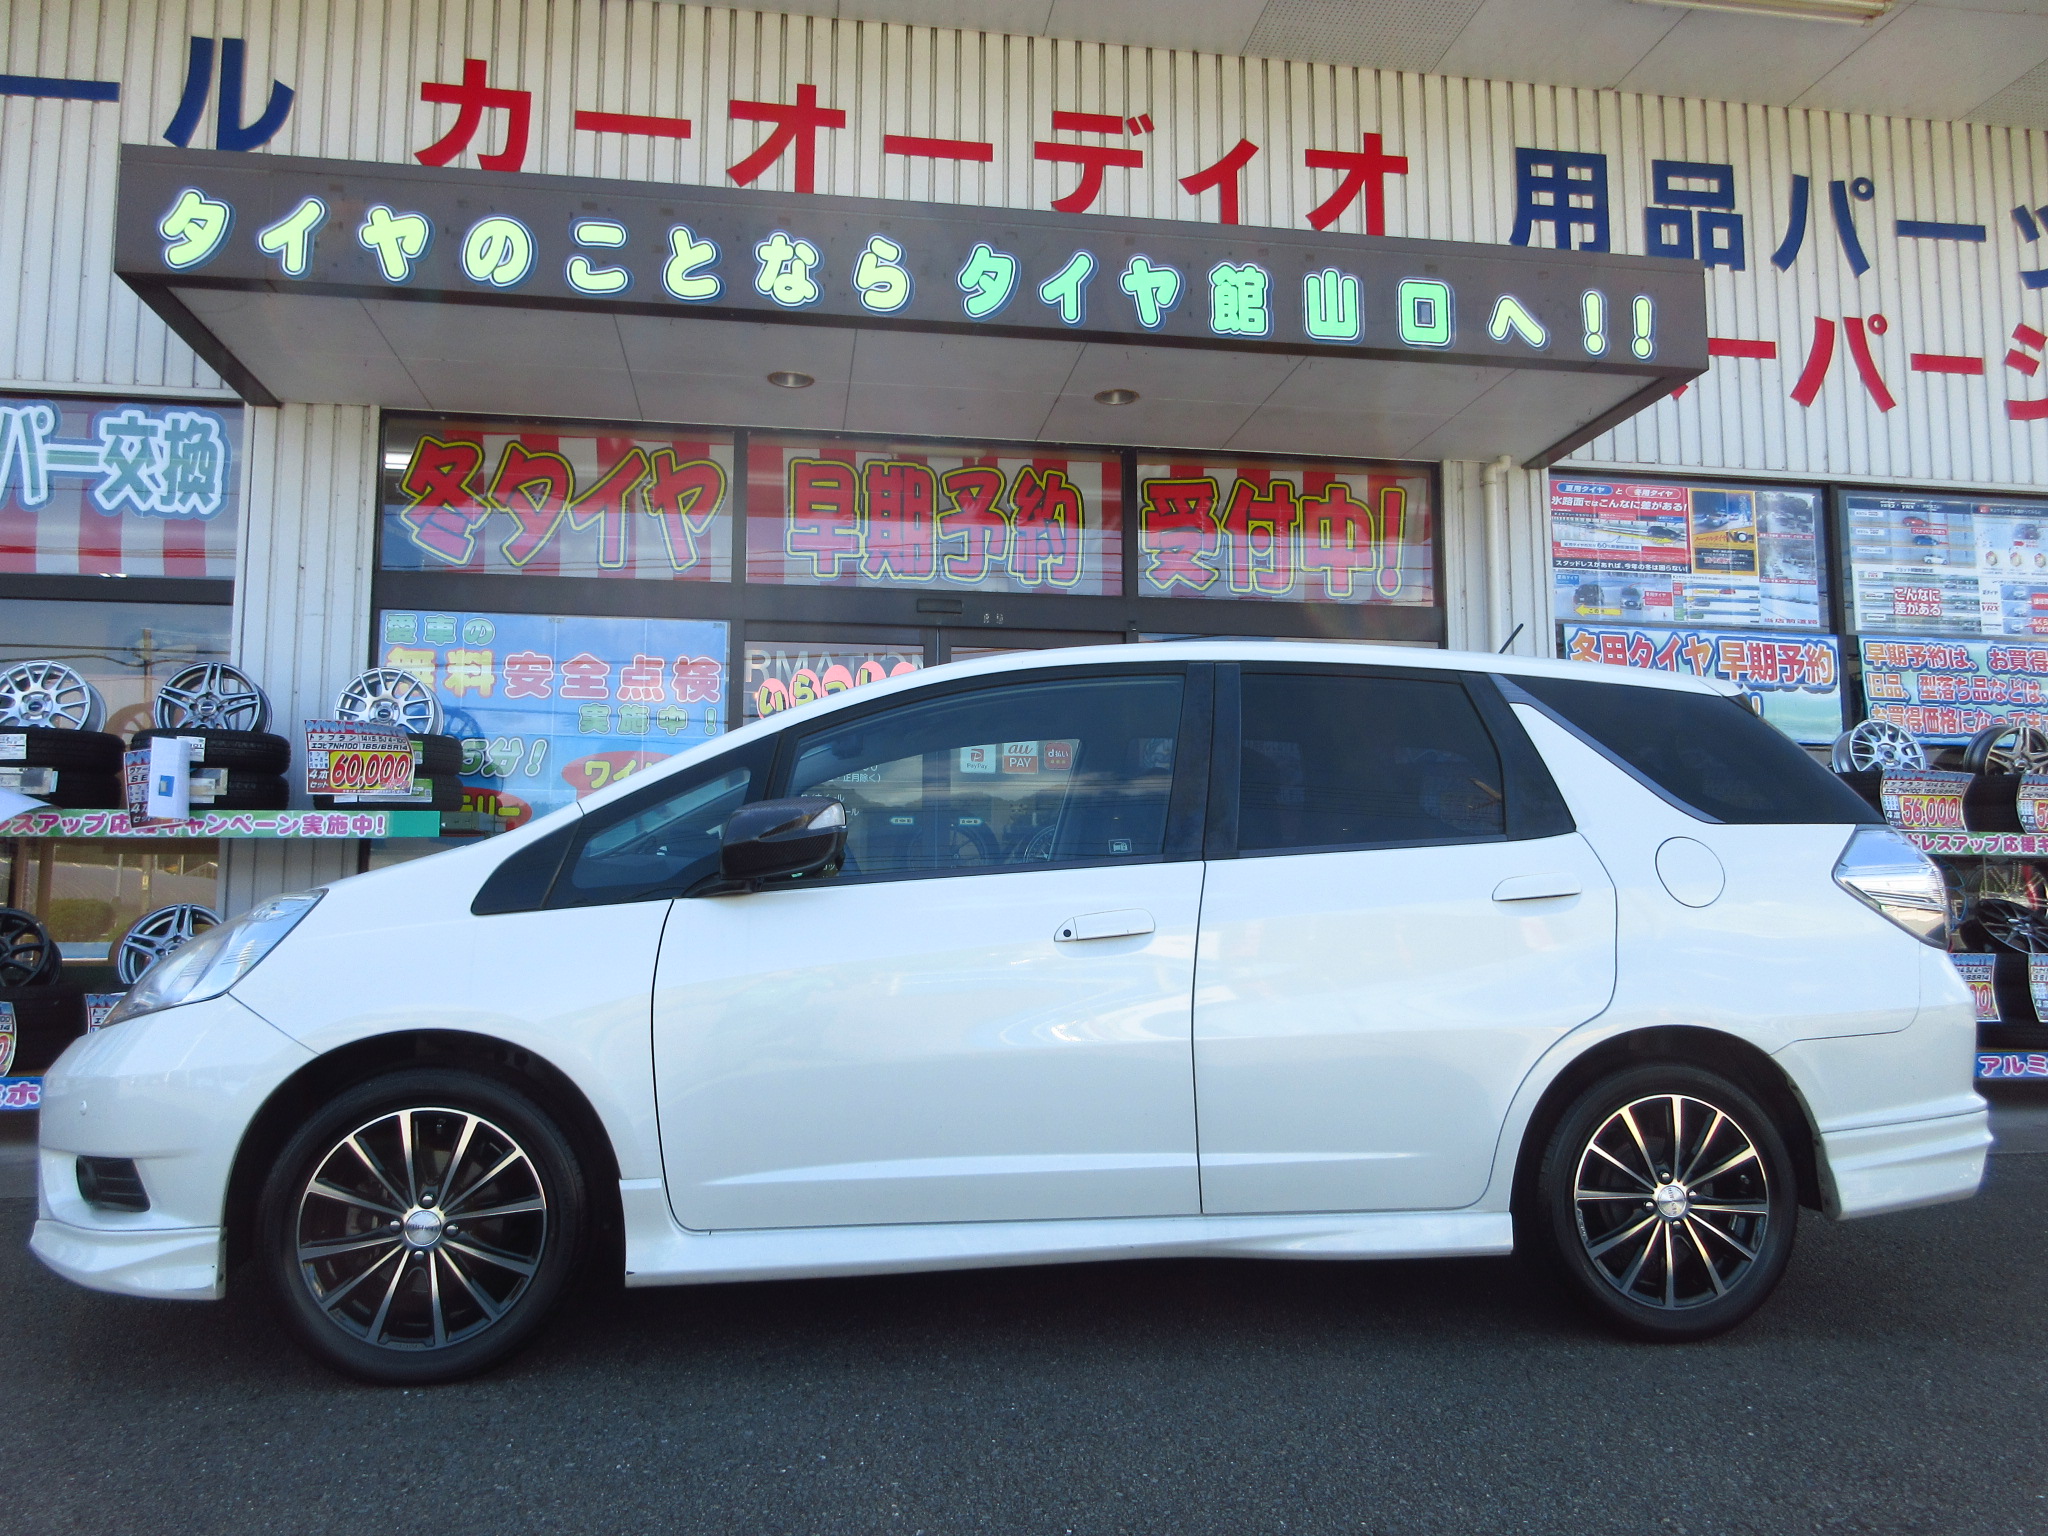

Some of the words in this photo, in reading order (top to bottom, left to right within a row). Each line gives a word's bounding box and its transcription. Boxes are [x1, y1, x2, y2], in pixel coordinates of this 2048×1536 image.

[414, 58, 1408, 236] カーオーディオ
[1615, 487, 1623, 495] と
[401, 435, 728, 572] 冬タイヤ
[787, 457, 1084, 588] 早期予約
[1141, 475, 1406, 598] 受付中!
[1894, 587, 1941, 601] こんなに
[1894, 601, 1942, 616] 差がある
[1981, 604, 2000, 613] VRX
[386, 647, 722, 703] 無料安全点検
[1719, 640, 1834, 685] 早期予約
[578, 703, 717, 736] 実施中!
[1008, 744, 1034, 755] au
[1009, 757, 1032, 768] PAY
[331, 753, 411, 787] 60,000
[1902, 796, 1960, 827] 56,000
[1978, 1054, 2048, 1077] アルミ
